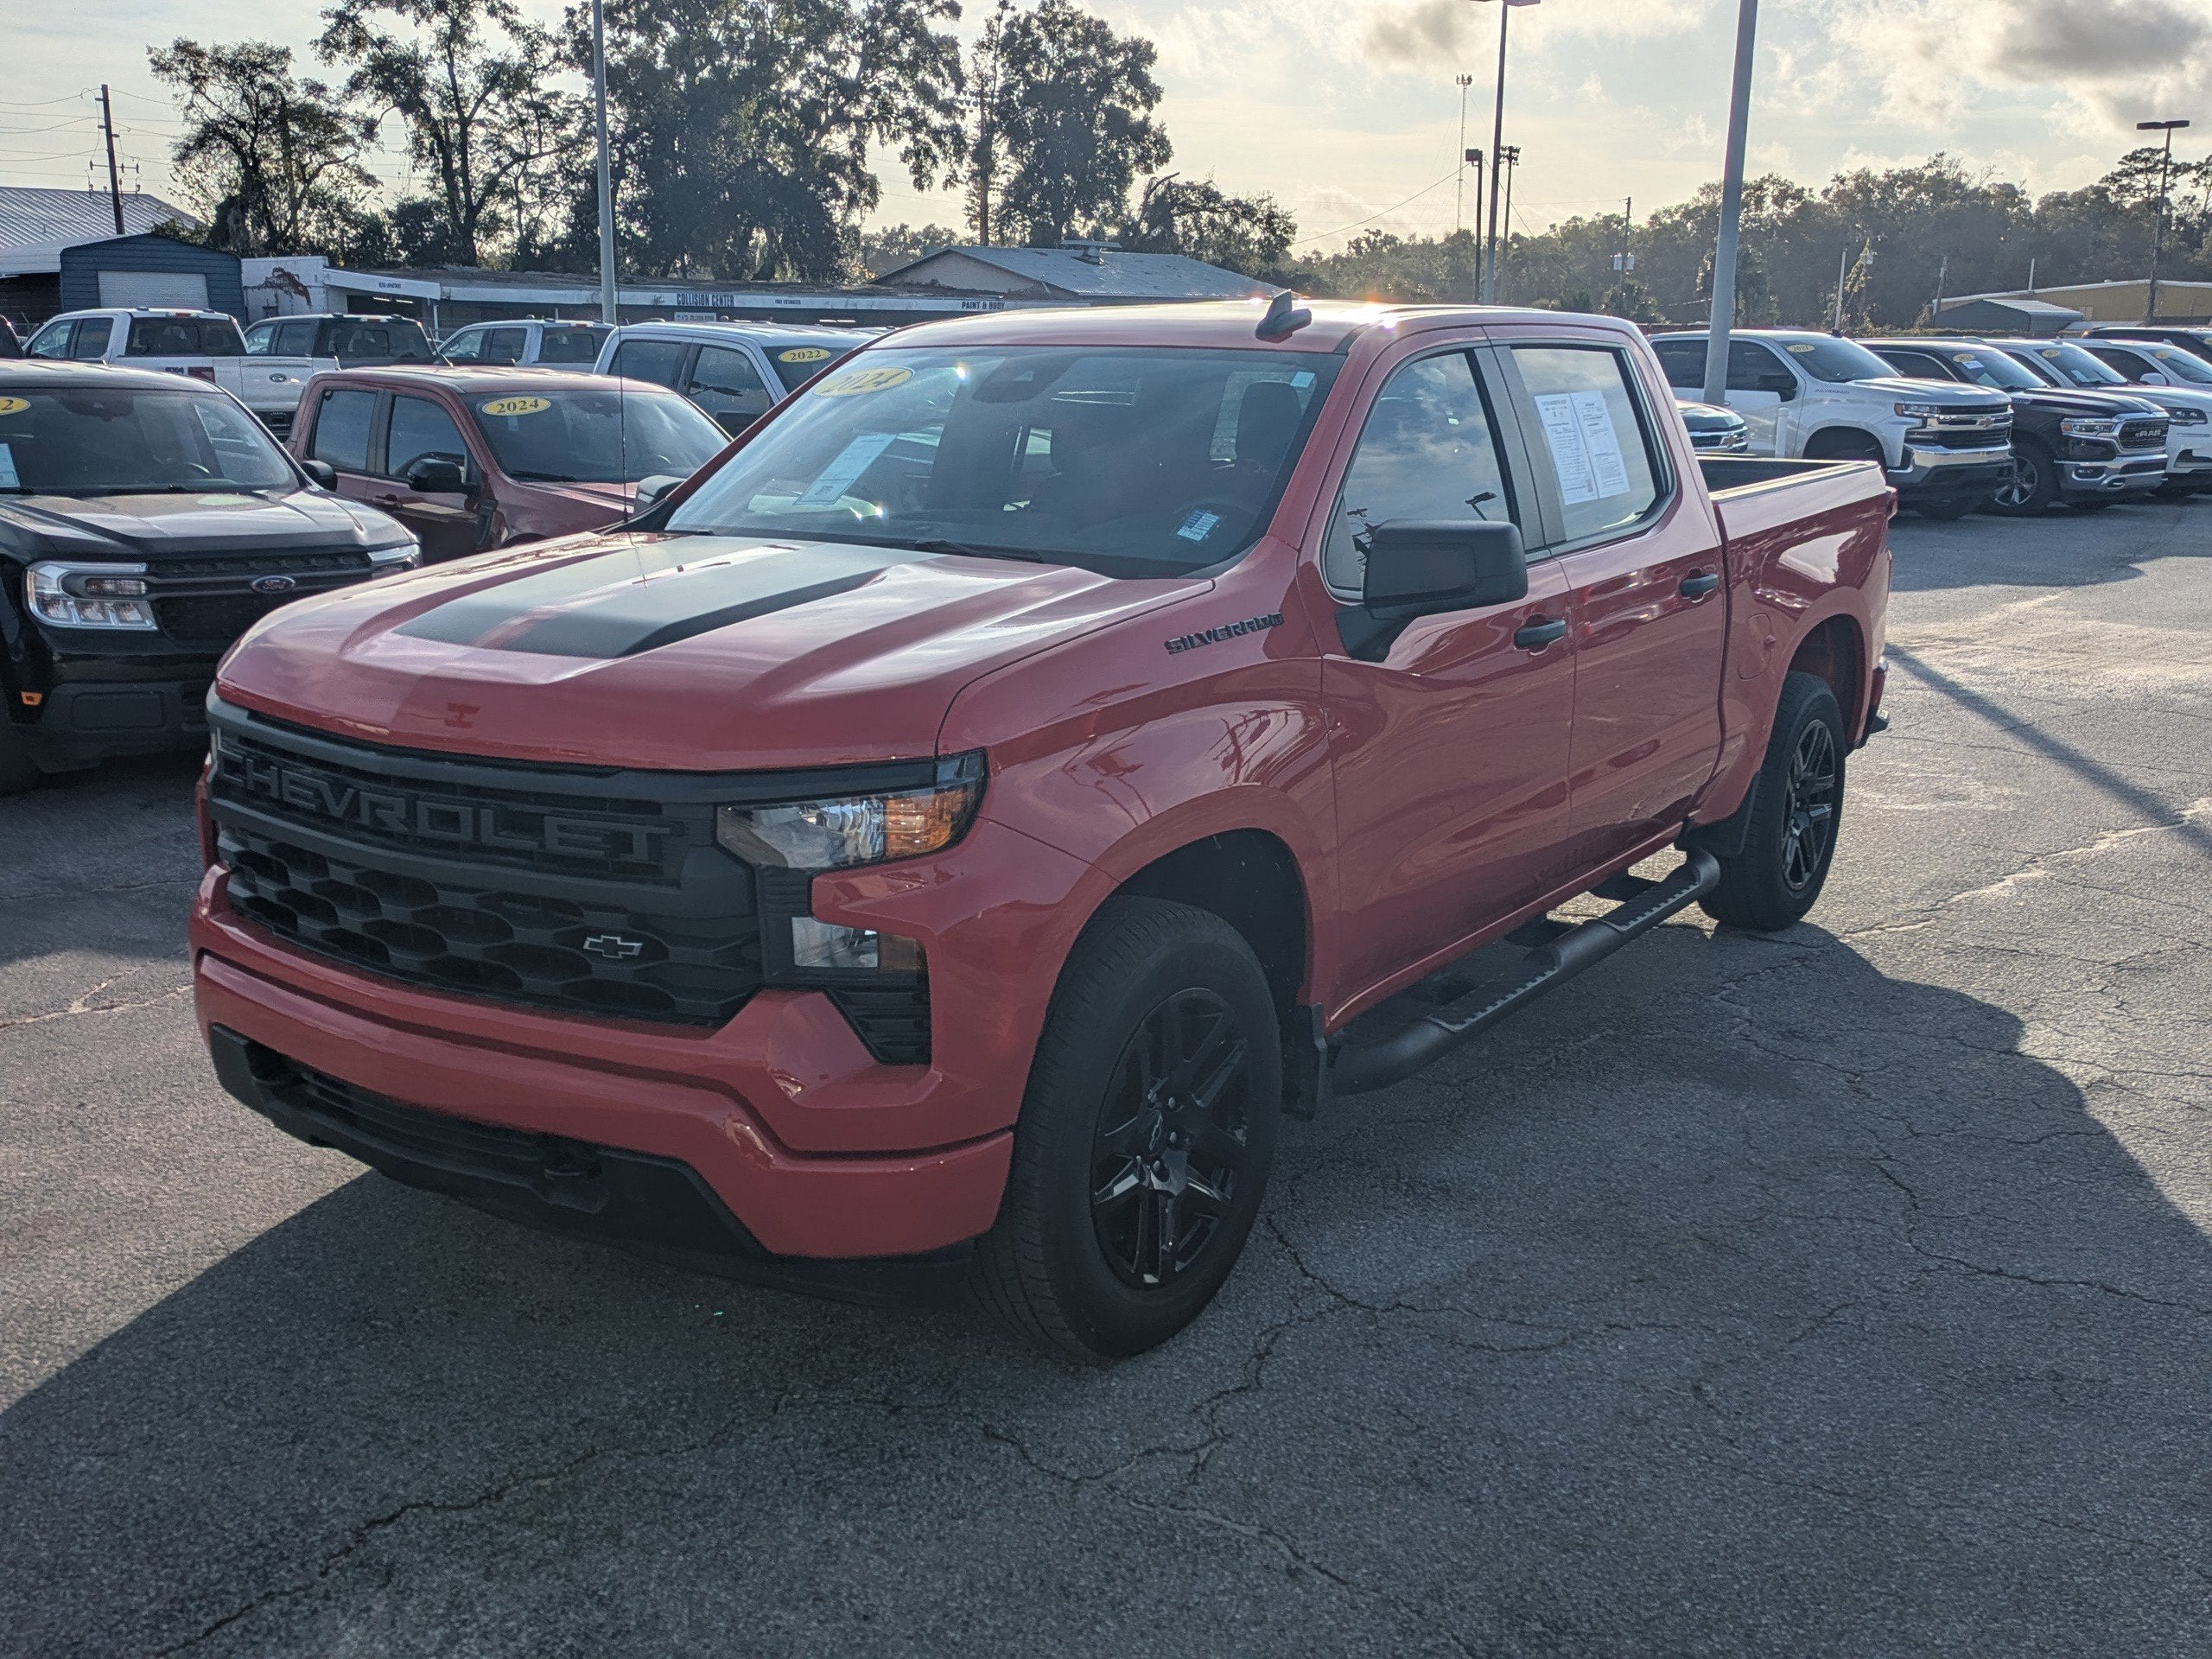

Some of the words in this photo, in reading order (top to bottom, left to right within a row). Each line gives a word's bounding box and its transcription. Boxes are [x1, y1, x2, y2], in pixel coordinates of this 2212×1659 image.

[677, 293, 709, 305] COLLISION
[712, 294, 734, 307] CENTER
[962, 301, 981, 309] PAINT
[988, 302, 1005, 310] BODY
[790, 350, 821, 361] 2022
[496, 398, 539, 414] 2024
[1164, 612, 1285, 655] SILVERADO
[217, 743, 673, 862] CHEVROLET
